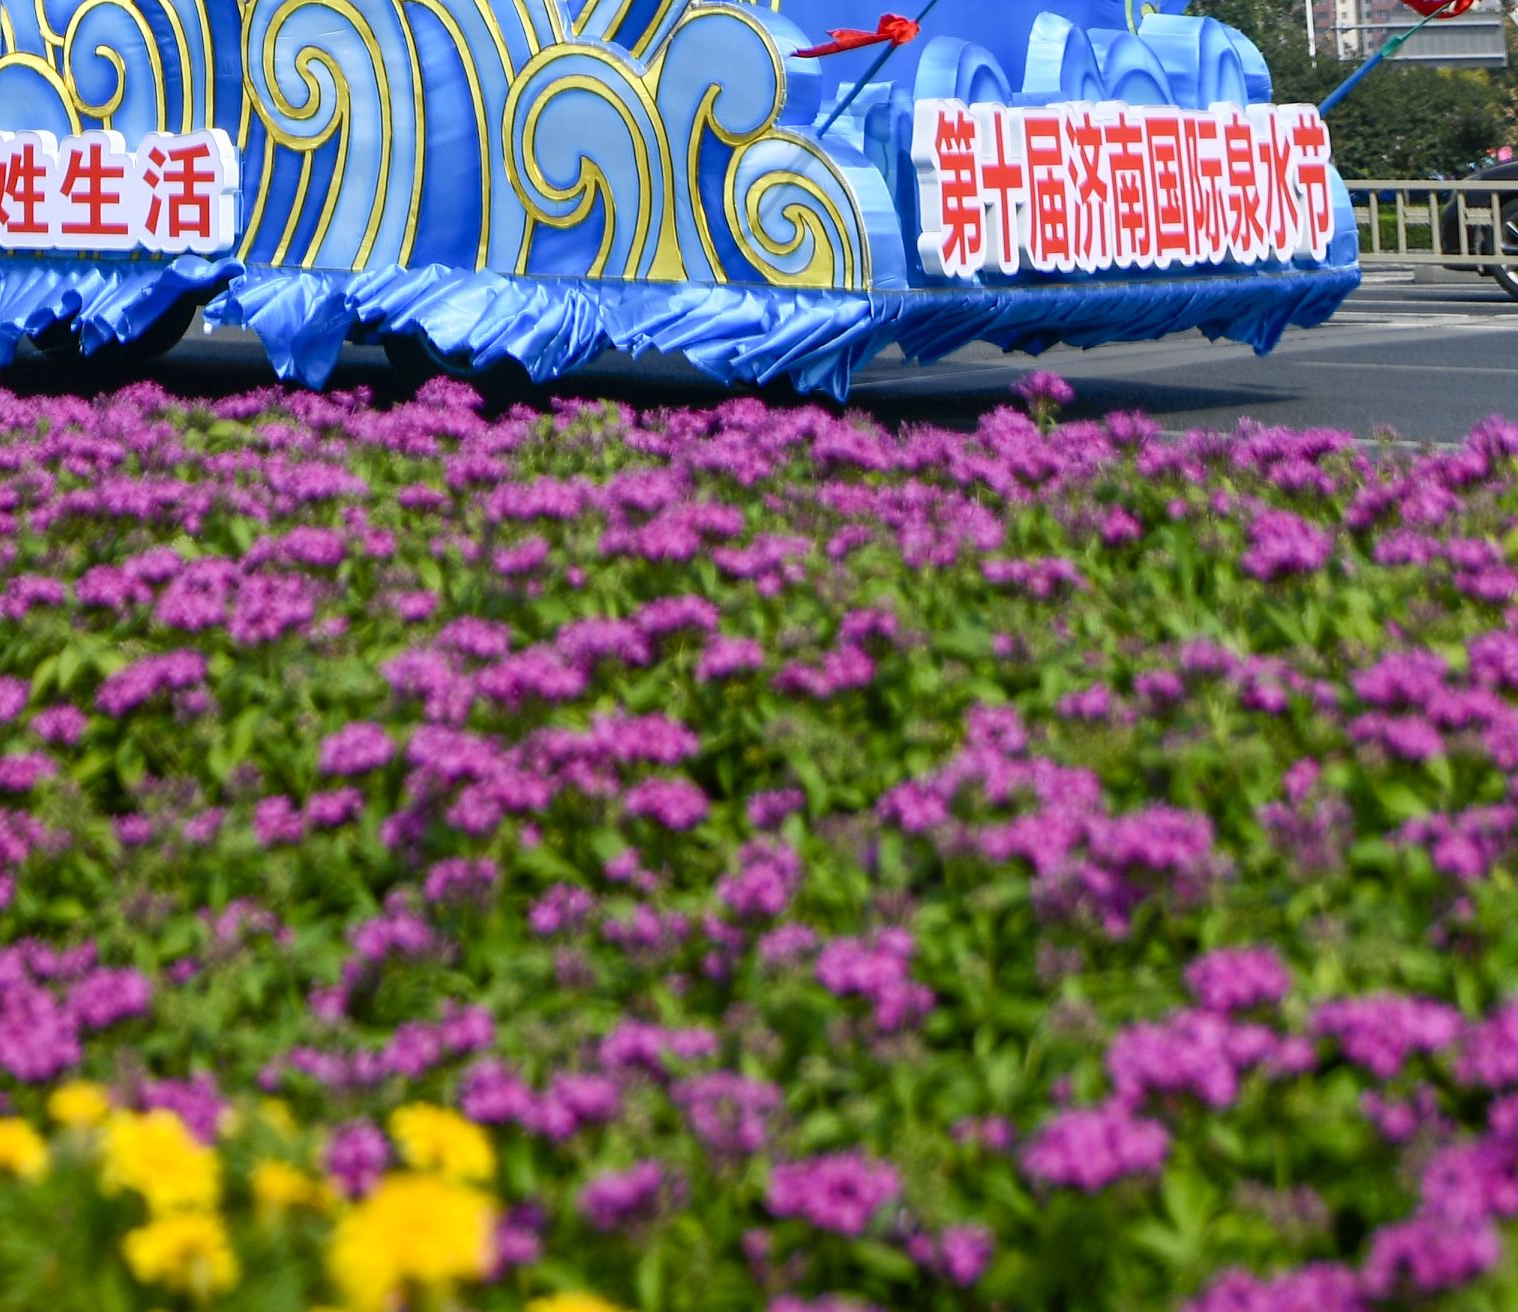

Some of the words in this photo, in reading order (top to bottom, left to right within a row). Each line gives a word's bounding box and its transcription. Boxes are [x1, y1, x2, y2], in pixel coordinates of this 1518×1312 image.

[934, 109, 1330, 265] 第十届济南国际泉水节
